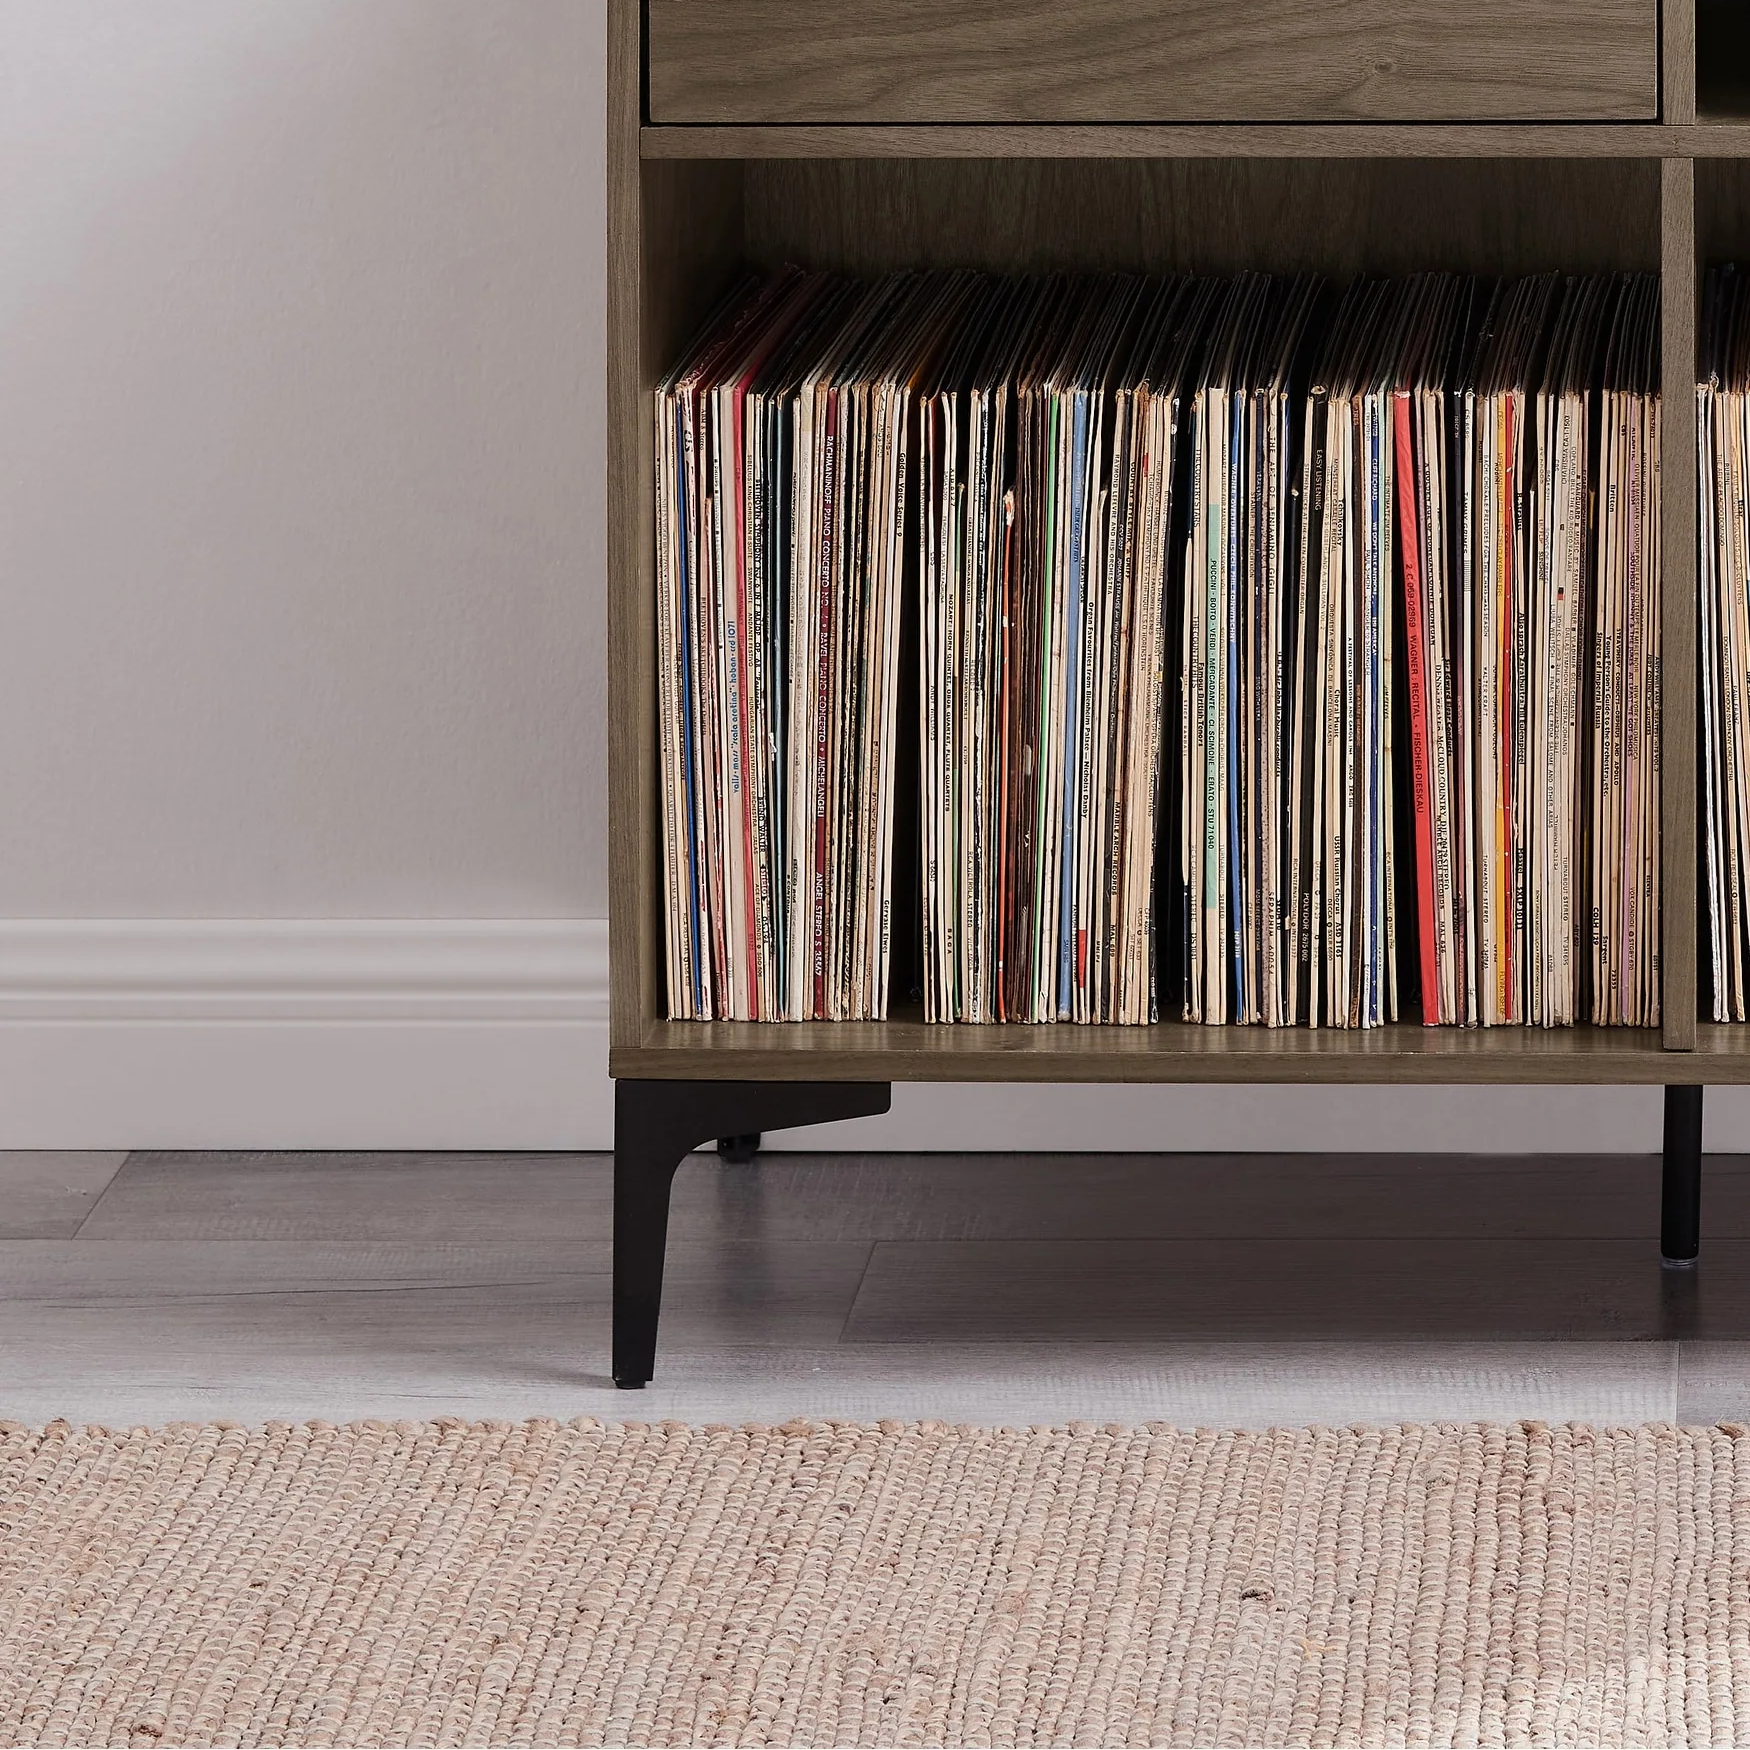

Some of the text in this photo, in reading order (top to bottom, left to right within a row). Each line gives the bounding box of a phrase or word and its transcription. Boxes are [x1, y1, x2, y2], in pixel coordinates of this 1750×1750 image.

[824, 436, 834, 504] RACHMANINOFF
[823, 508, 831, 536] PIANO
[822, 541, 830, 587] CONCERTO
[1107, 554, 1115, 595] ORCHESTRA
[1595, 632, 1603, 658] Singers
[1596, 661, 1602, 669] of
[818, 696, 826, 742] CONCERTO
[1410, 635, 1418, 674] WAGNER
[1414, 733, 1423, 813] FISCHER-DIESKAU
[1605, 717, 1610, 725] to
[815, 872, 823, 900] ANGEL
